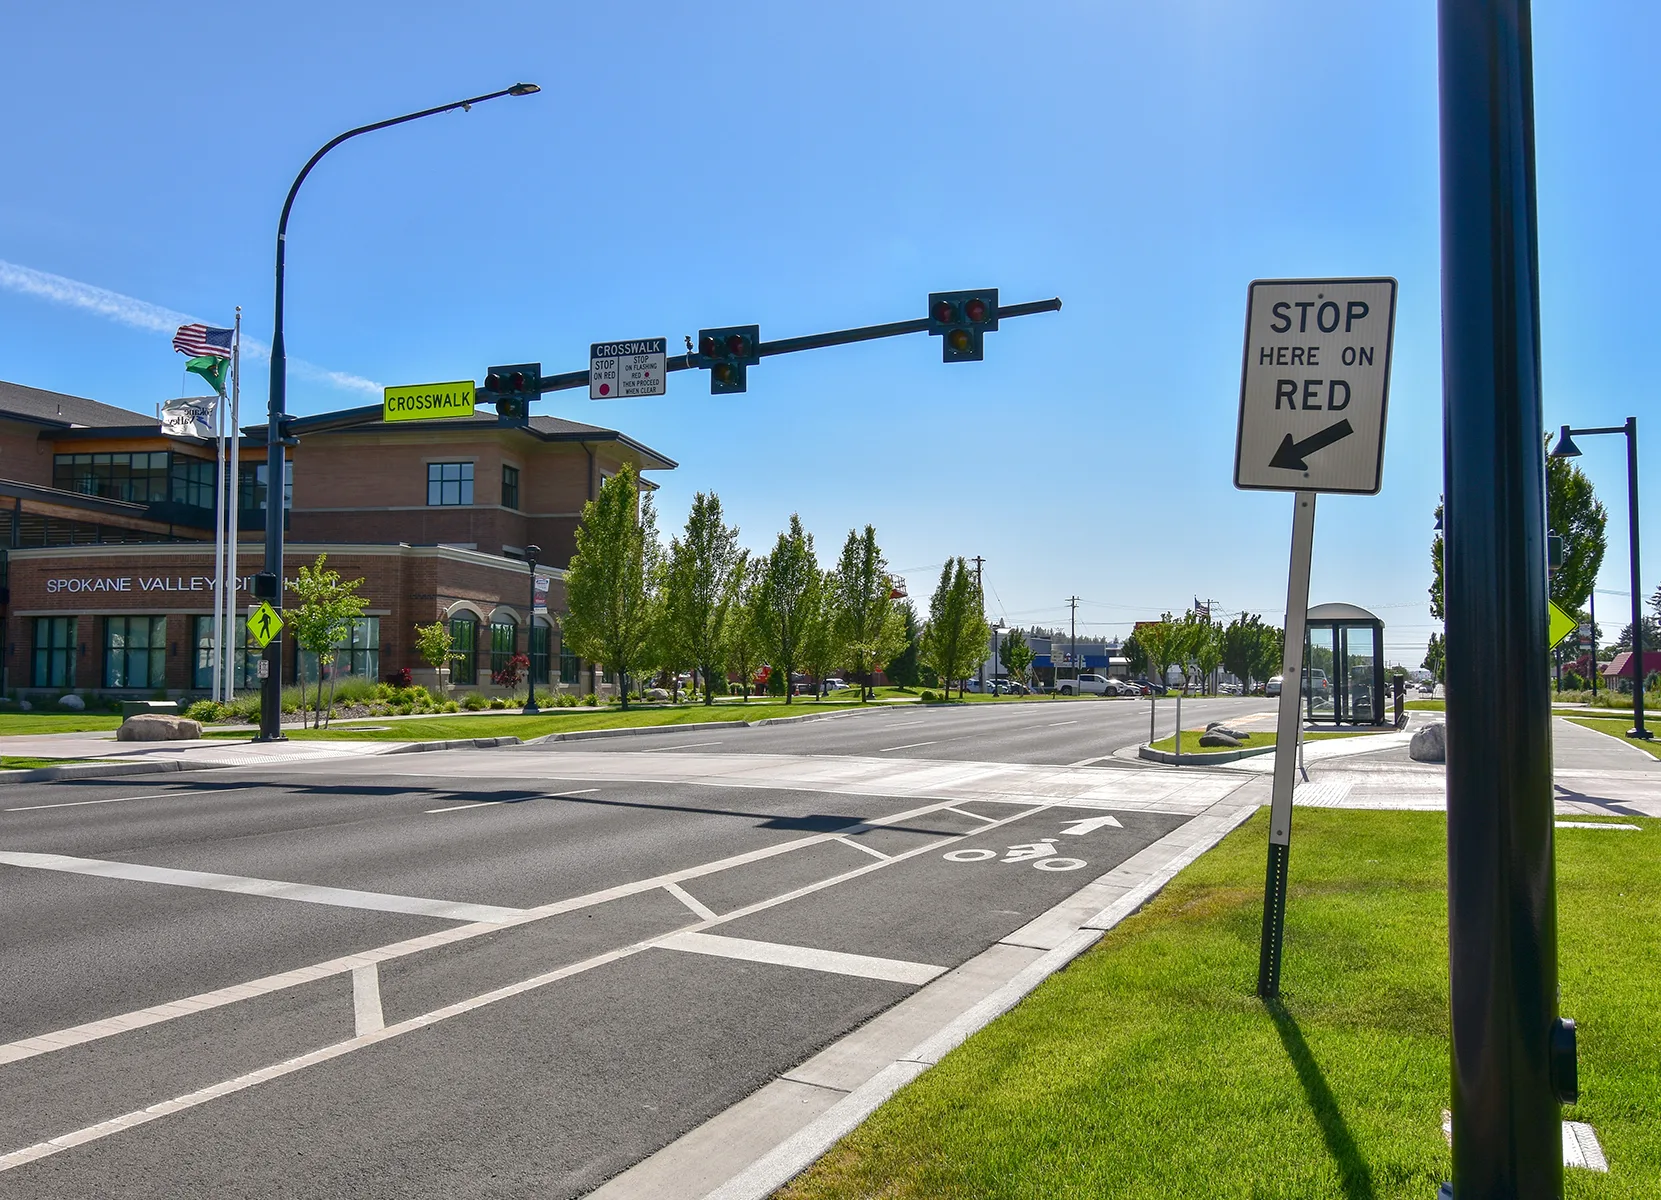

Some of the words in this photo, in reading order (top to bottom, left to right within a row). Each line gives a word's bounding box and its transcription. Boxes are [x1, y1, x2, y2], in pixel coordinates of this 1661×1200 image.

[1270, 301, 1370, 333] STOP
[596, 341, 660, 357] CROSSWALK
[1259, 346, 1320, 366] HERE
[1341, 346, 1375, 366] ON
[595, 360, 615, 371] STOP
[625, 364, 633, 372] ON
[633, 363, 657, 371] FLASHING
[633, 355, 650, 364] STOP
[593, 372, 603, 380] ON
[603, 371, 616, 380] RED
[622, 380, 636, 388] THEN
[636, 379, 660, 387] PROCEED
[388, 391, 470, 411] CROSSWALK
[1275, 379, 1351, 410] RED
[47, 578, 131, 593] SPOKANE
[139, 577, 217, 591] VALLEY
